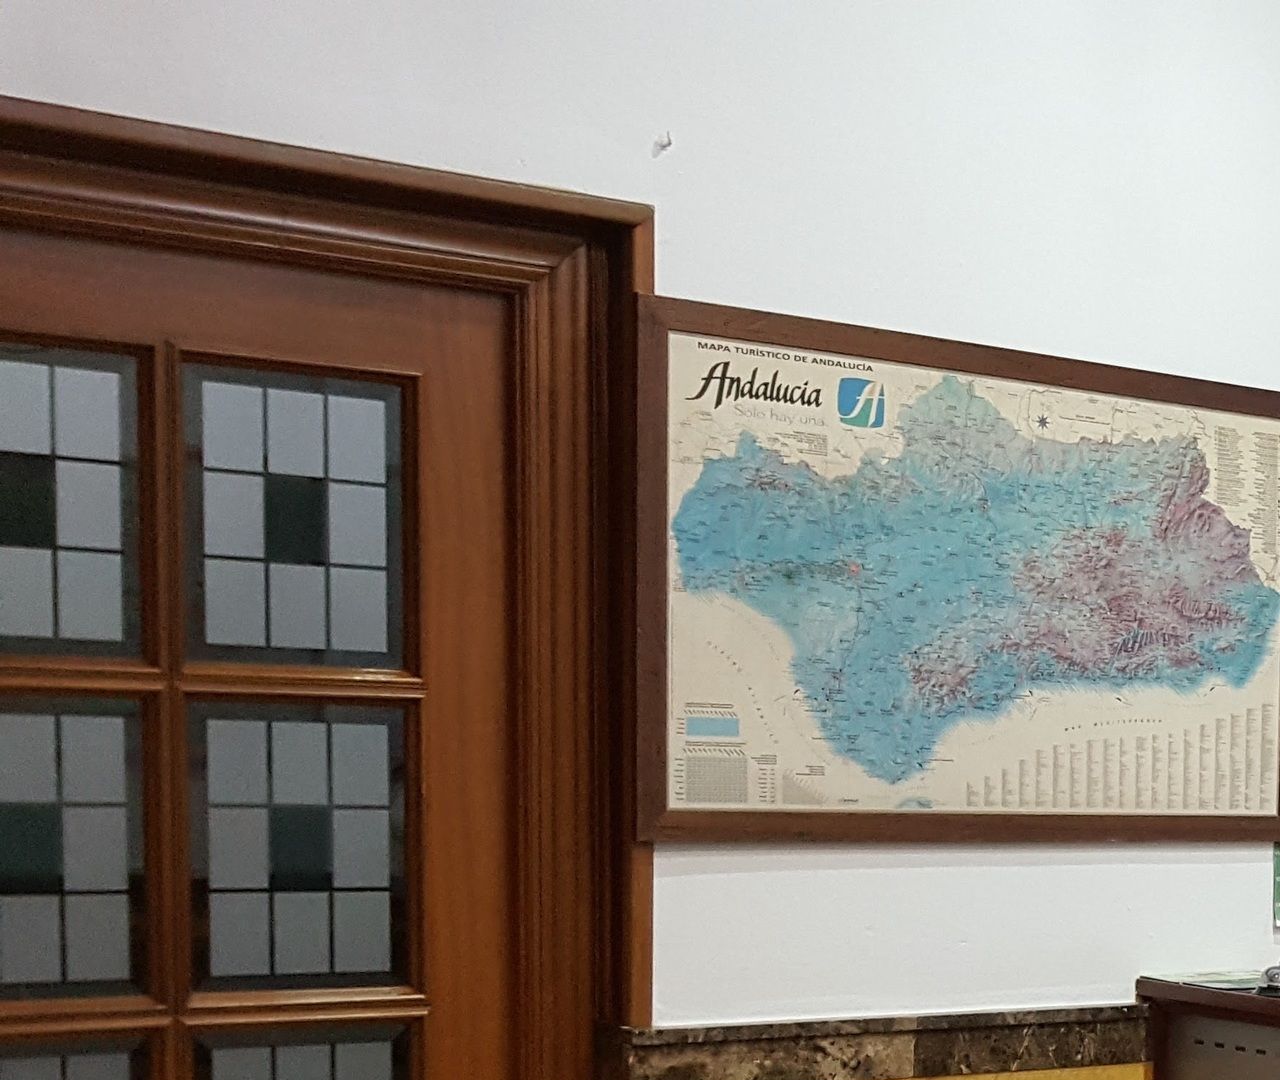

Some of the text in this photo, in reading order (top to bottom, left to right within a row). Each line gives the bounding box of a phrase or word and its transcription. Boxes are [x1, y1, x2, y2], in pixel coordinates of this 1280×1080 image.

[698, 342, 874, 372] MAPA TURÍSTICO DE ANDALUCÍA
[770, 409, 794, 425] hay
